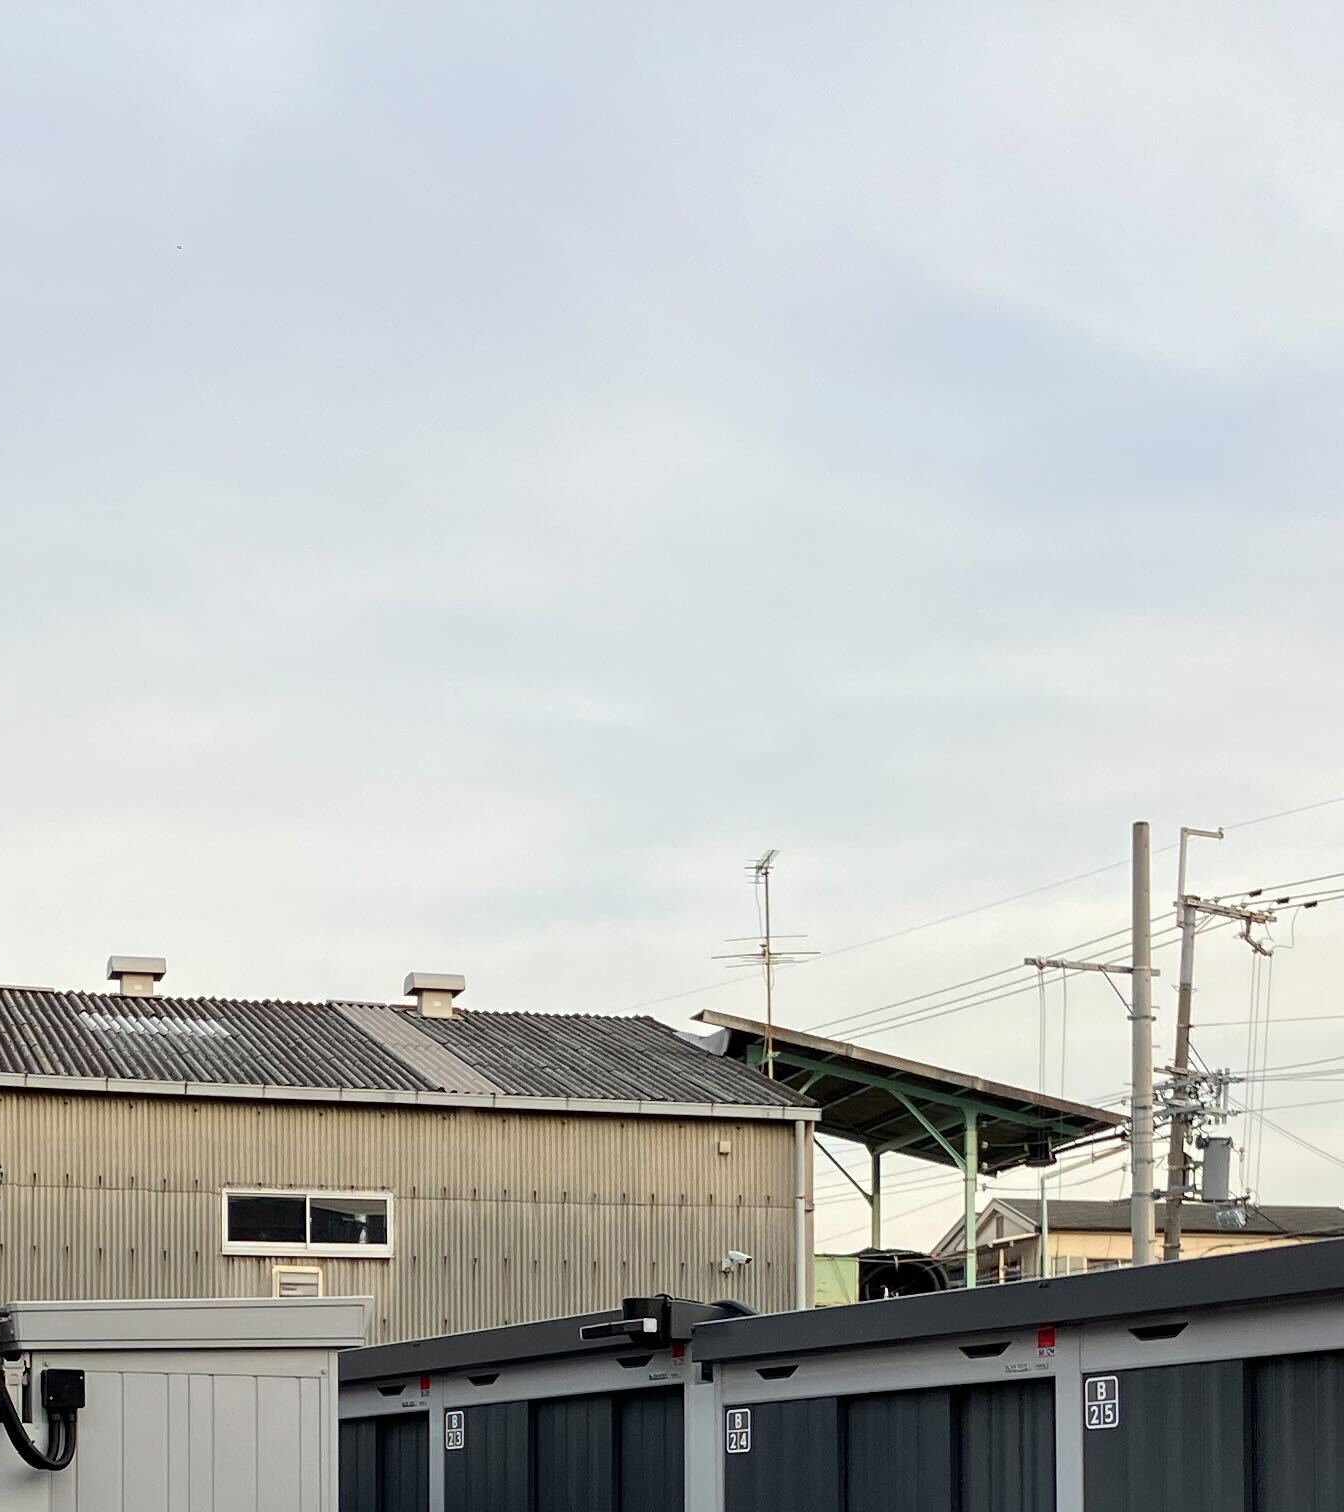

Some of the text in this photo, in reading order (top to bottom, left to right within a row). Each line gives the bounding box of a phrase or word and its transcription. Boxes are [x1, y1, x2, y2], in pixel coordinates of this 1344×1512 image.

[1097, 1381, 1106, 1400] B
[451, 1414, 458, 1428] B
[734, 1413, 742, 1429] B
[1090, 1404, 1114, 1424] 25
[448, 1431, 461, 1446] 23
[730, 1432, 747, 1449] 24
